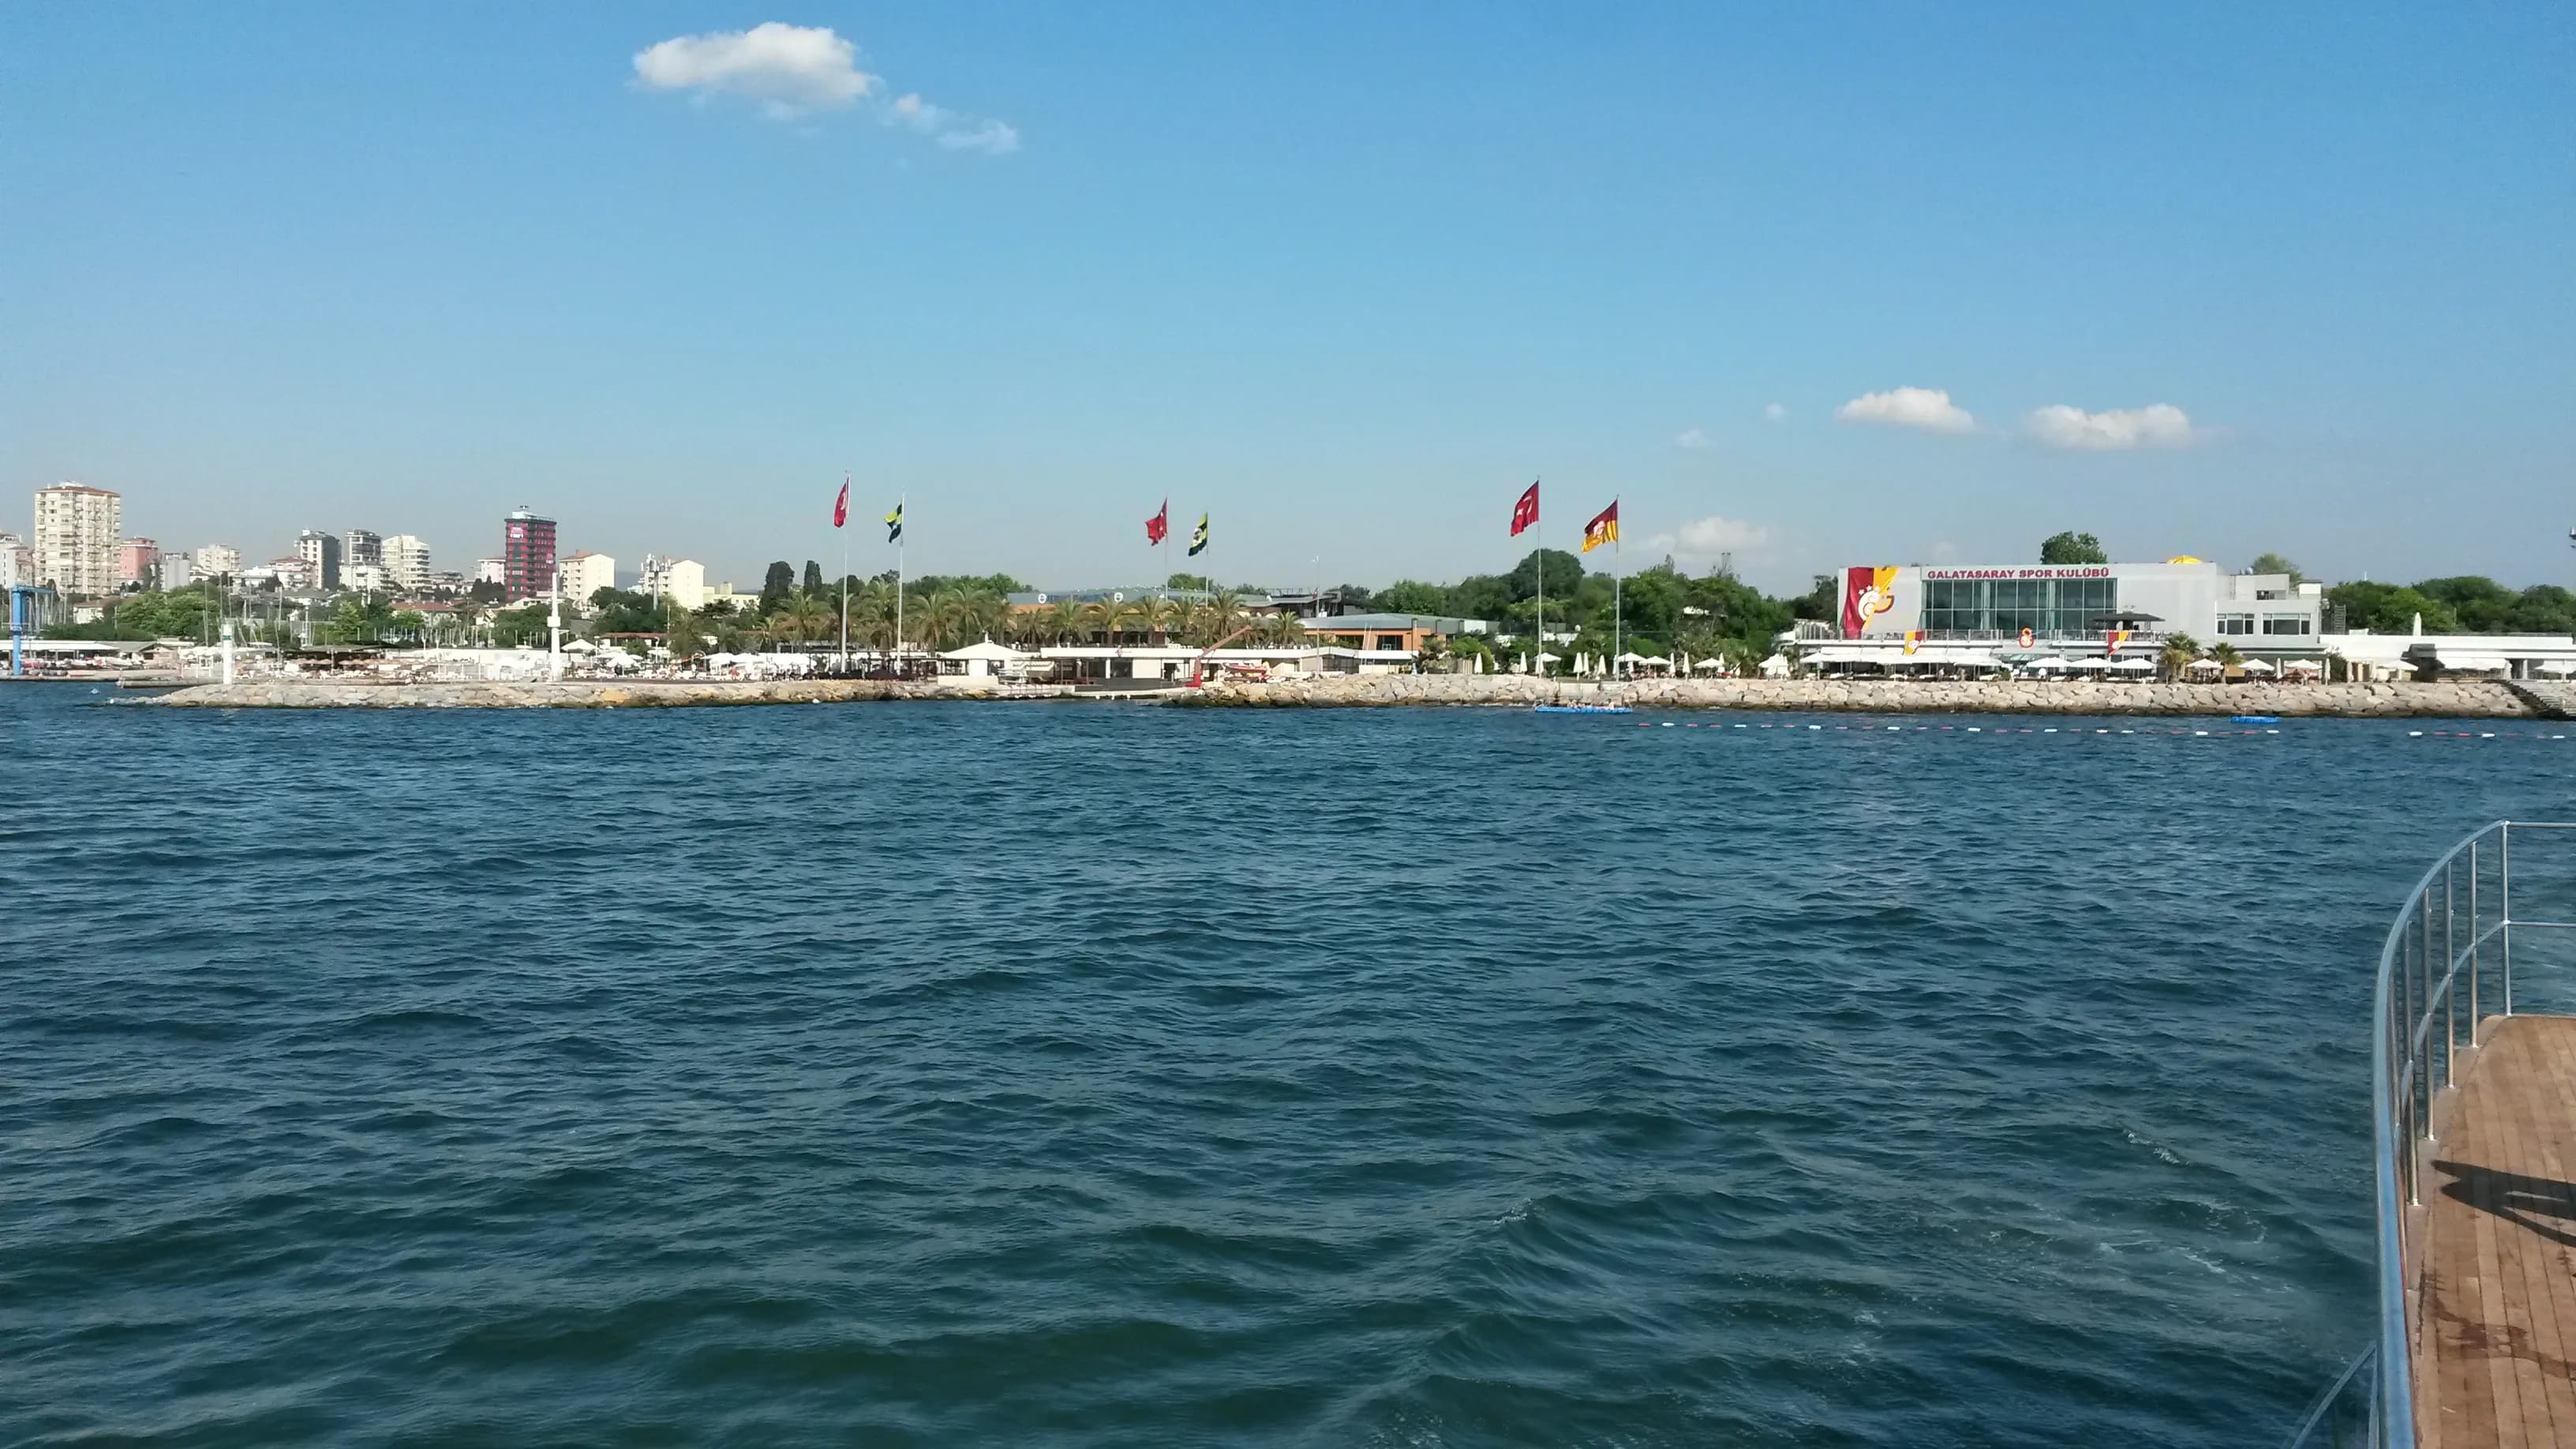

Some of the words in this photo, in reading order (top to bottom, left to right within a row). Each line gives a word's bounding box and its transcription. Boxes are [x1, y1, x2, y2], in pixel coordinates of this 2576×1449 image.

[1927, 570, 2016, 579] GALATASARAY
[2019, 569, 2053, 578] SPOR
[2056, 567, 2110, 578] KULÜBÜ
